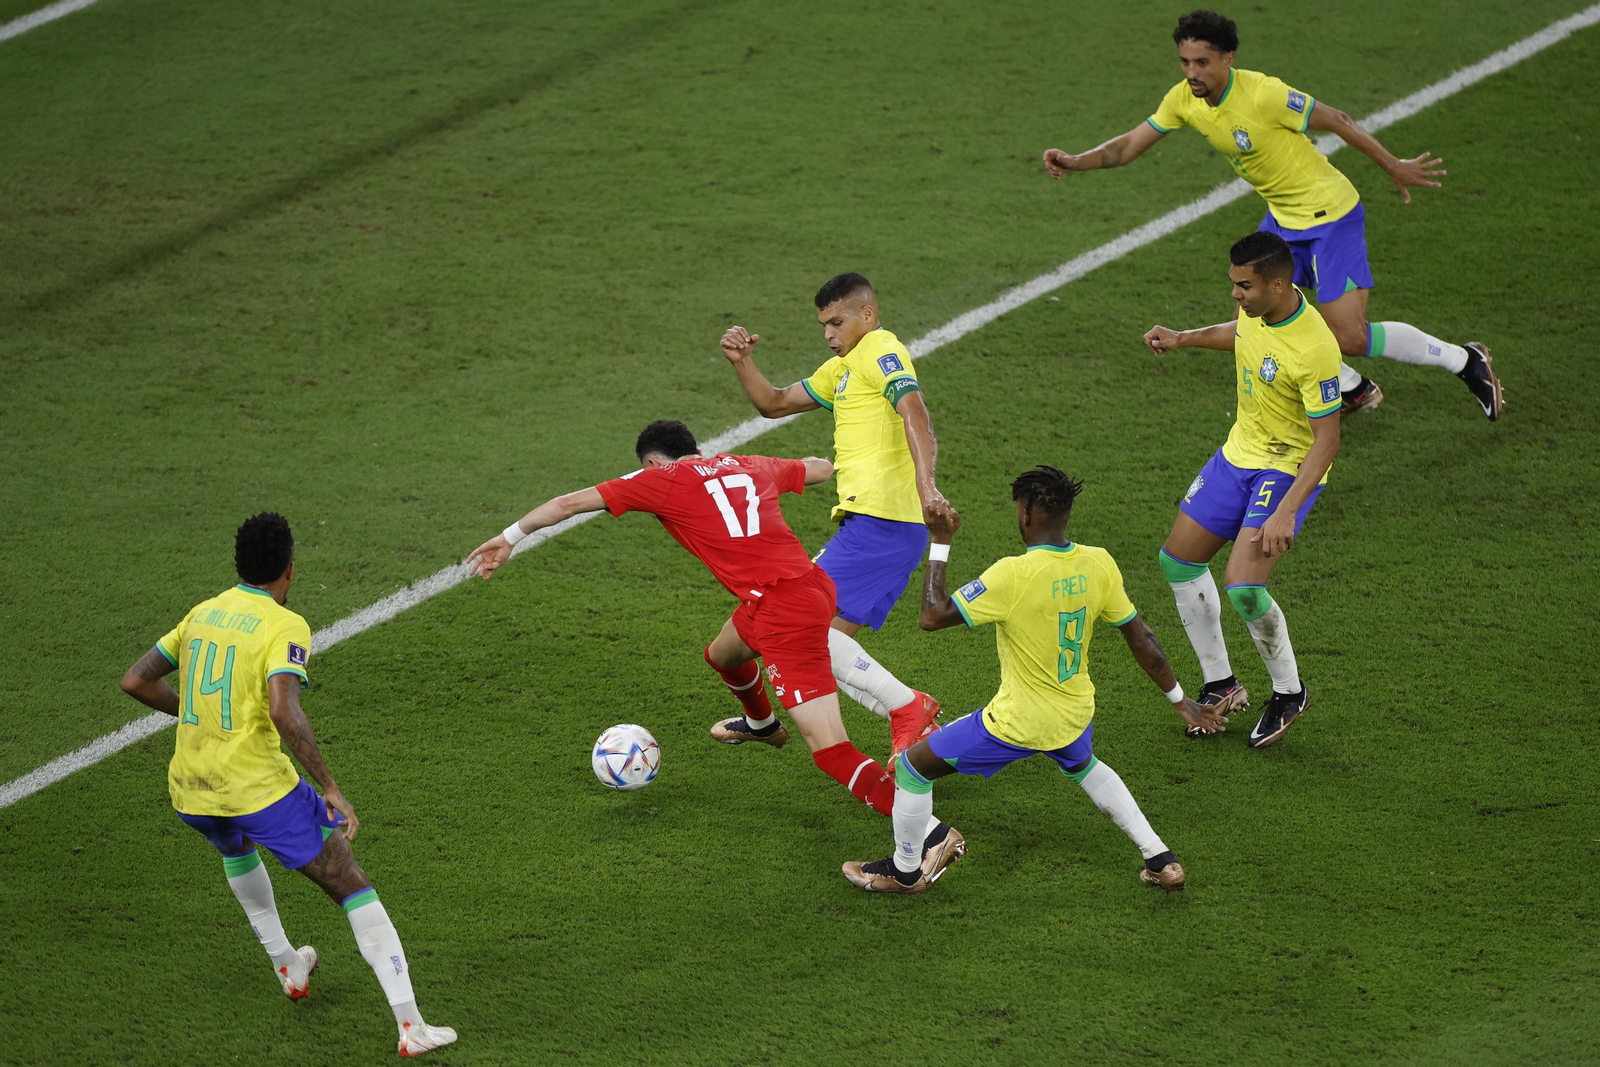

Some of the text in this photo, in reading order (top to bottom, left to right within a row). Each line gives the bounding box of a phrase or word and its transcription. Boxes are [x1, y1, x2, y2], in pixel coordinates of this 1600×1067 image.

[1243, 365, 1254, 398] 5
[703, 473, 760, 538] 17
[1254, 480, 1276, 508] 5
[1052, 574, 1088, 600] FRED
[1057, 605, 1087, 685] 8
[182, 638, 236, 731] 14
